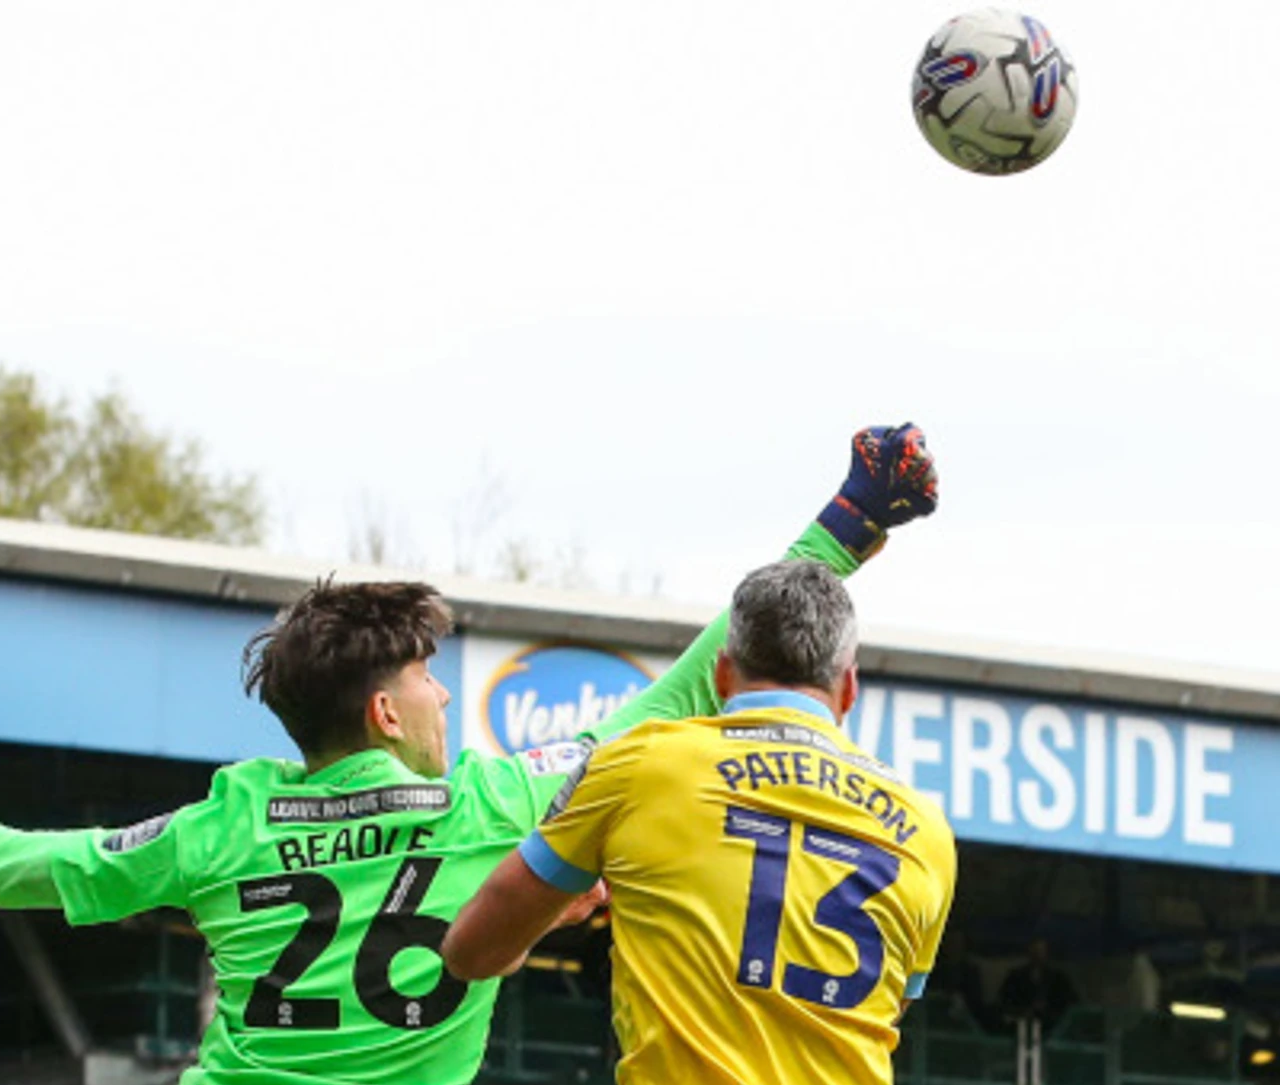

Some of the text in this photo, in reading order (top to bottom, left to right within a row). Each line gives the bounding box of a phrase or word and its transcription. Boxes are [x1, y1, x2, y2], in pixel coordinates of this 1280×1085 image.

[715, 751, 919, 846] PATERSON
[236, 856, 472, 1031] 26
[722, 804, 901, 1010] 13
